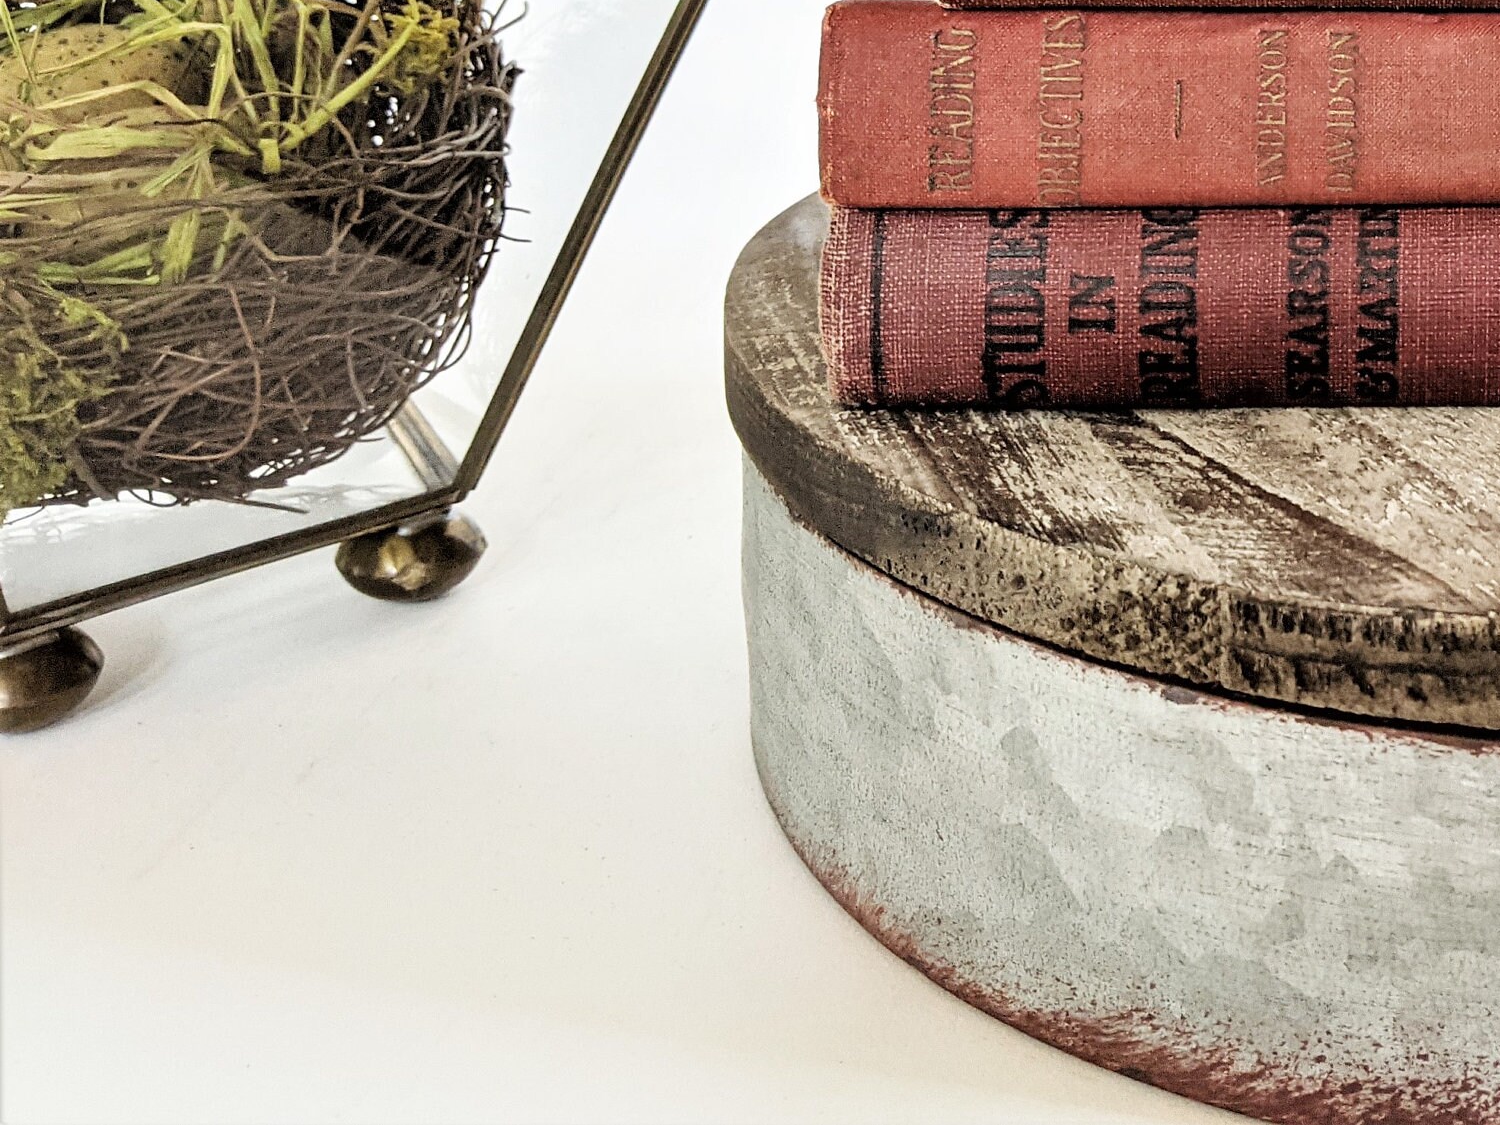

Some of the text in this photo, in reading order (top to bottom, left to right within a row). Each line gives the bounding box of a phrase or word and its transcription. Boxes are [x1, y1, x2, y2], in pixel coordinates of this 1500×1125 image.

[928, 27, 977, 192] READING
[1037, 13, 1086, 207] OBJECTIVES
[1256, 29, 1288, 187] ANDERSON
[1326, 30, 1357, 193] DAVIDSON
[981, 208, 1049, 406] STUDIES
[1069, 275, 1115, 334] IN
